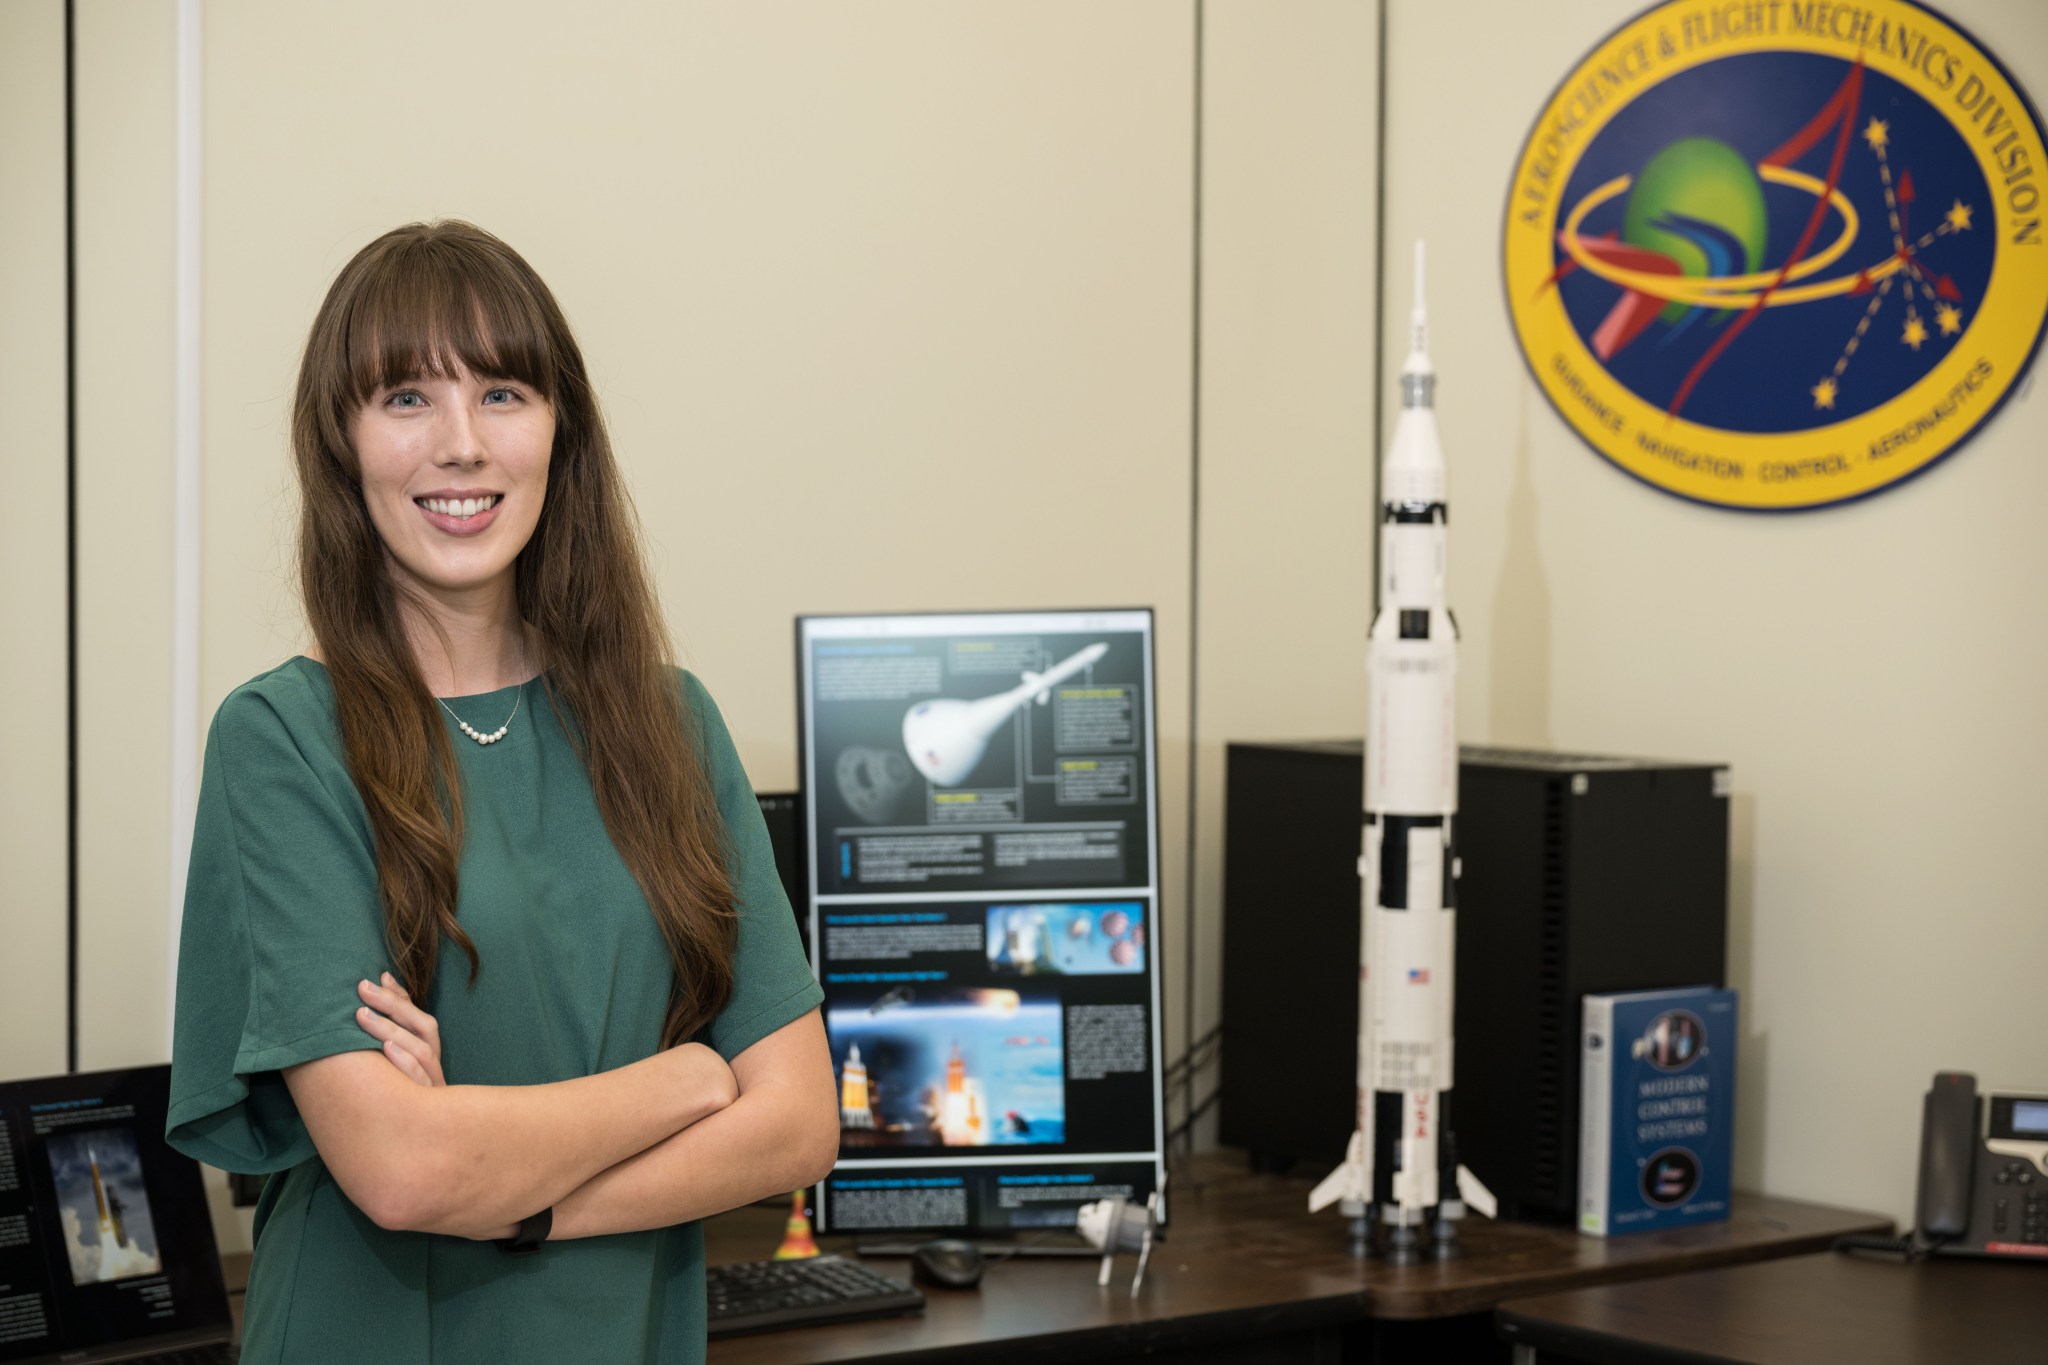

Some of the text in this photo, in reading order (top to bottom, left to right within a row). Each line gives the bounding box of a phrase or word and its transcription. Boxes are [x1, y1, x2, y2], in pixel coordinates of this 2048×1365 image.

[1520, 0, 2042, 248] AEROSCIENCE & FLIGHT MECHANICS DIVISION
[1552, 352, 1994, 484] GUIDANCE NAVIGATION CONTROL AERONAUTICS
[1638, 1097, 1706, 1120] CONTROL
[1639, 1074, 1709, 1097] MODERN
[1414, 1091, 1430, 1139] USA
